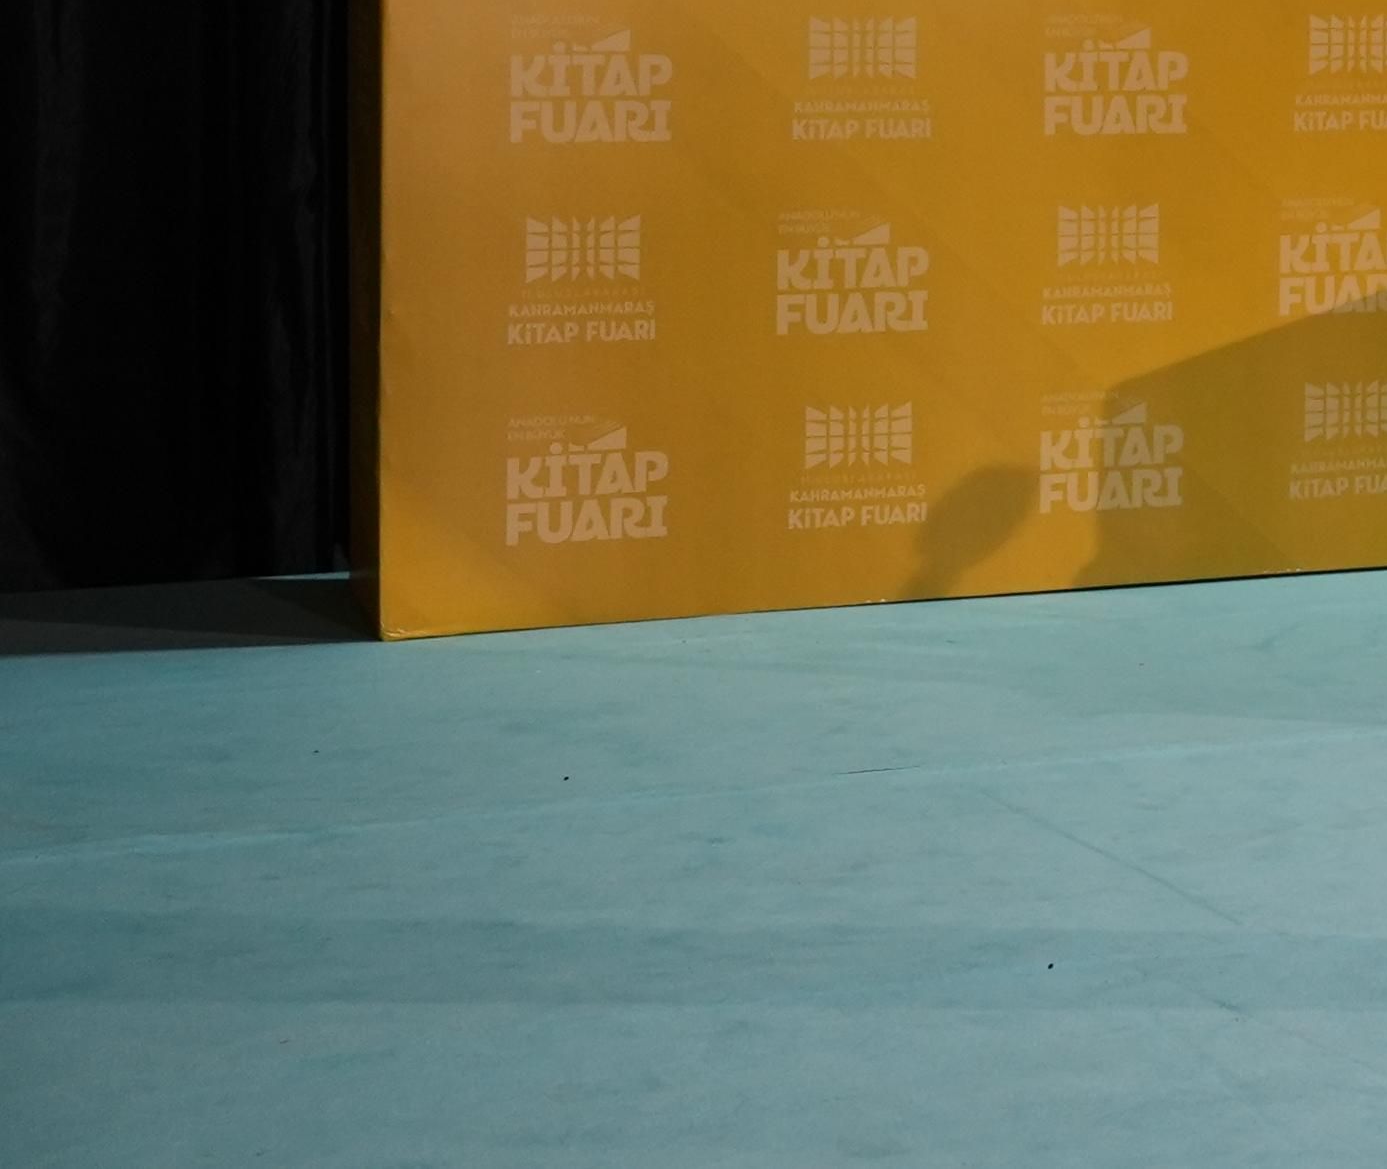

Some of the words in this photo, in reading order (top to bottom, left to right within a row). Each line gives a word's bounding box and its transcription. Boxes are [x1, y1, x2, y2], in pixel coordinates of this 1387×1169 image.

[510, 101, 672, 143] FUARI
[1044, 95, 1187, 135] FUARI
[777, 291, 928, 335] FUARI
[1039, 468, 1183, 513] FUARI
[505, 496, 668, 546] FUARI
